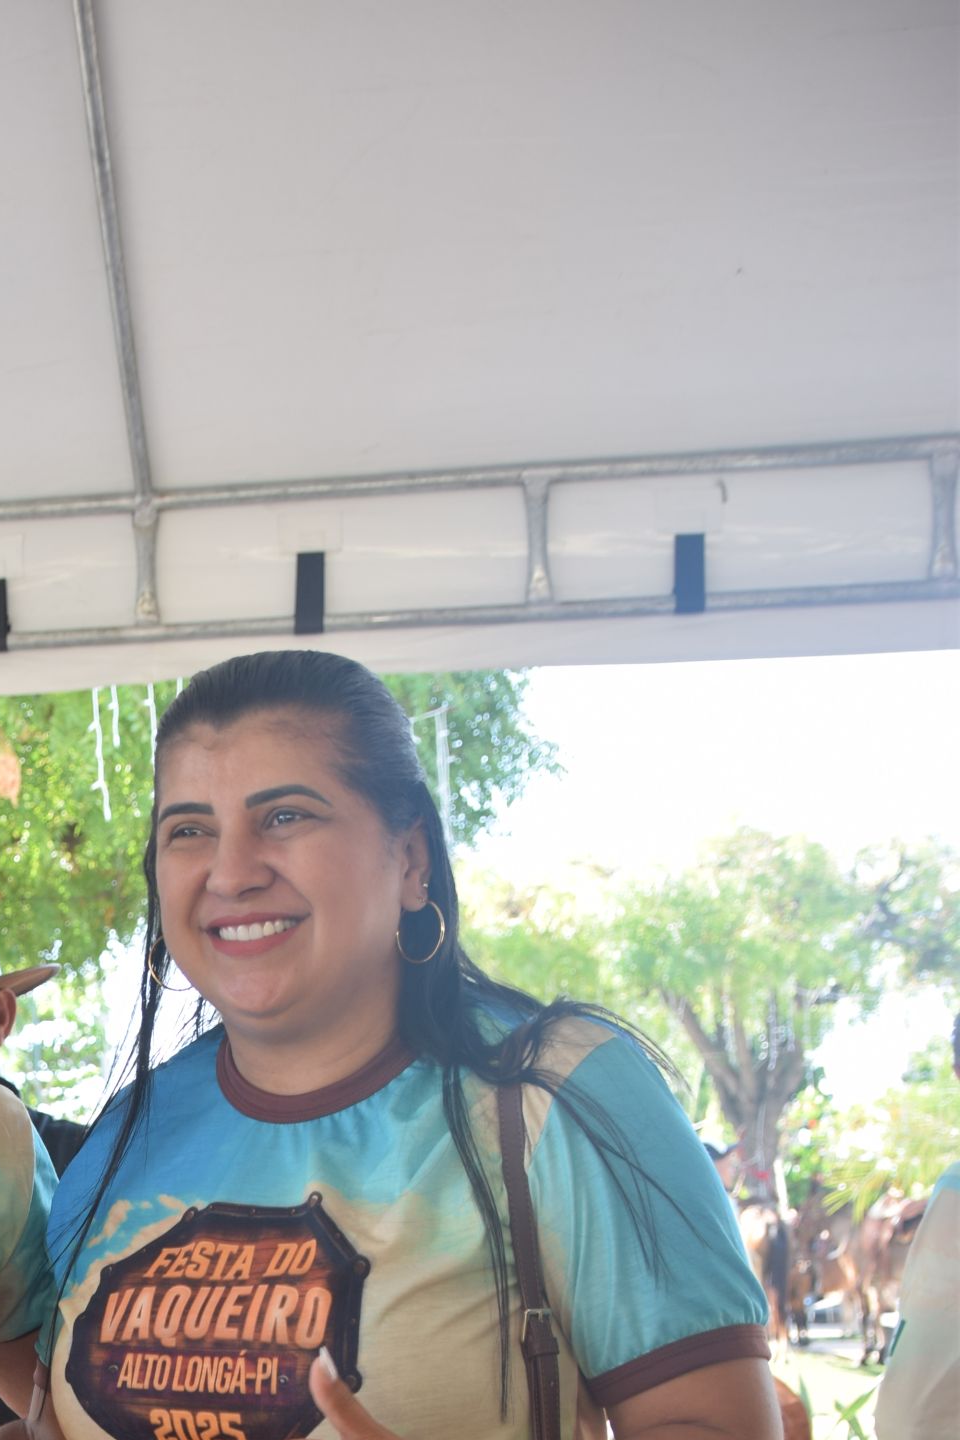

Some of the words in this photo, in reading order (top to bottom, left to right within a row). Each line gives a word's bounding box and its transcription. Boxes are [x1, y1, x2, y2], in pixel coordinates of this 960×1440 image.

[144, 1241, 254, 1280] FESTA
[264, 1239, 317, 1277] DO
[100, 1284, 332, 1349] VAQUEIRO
[117, 1353, 171, 1390] ALTO
[172, 1351, 278, 1394] LONGÁ-PI
